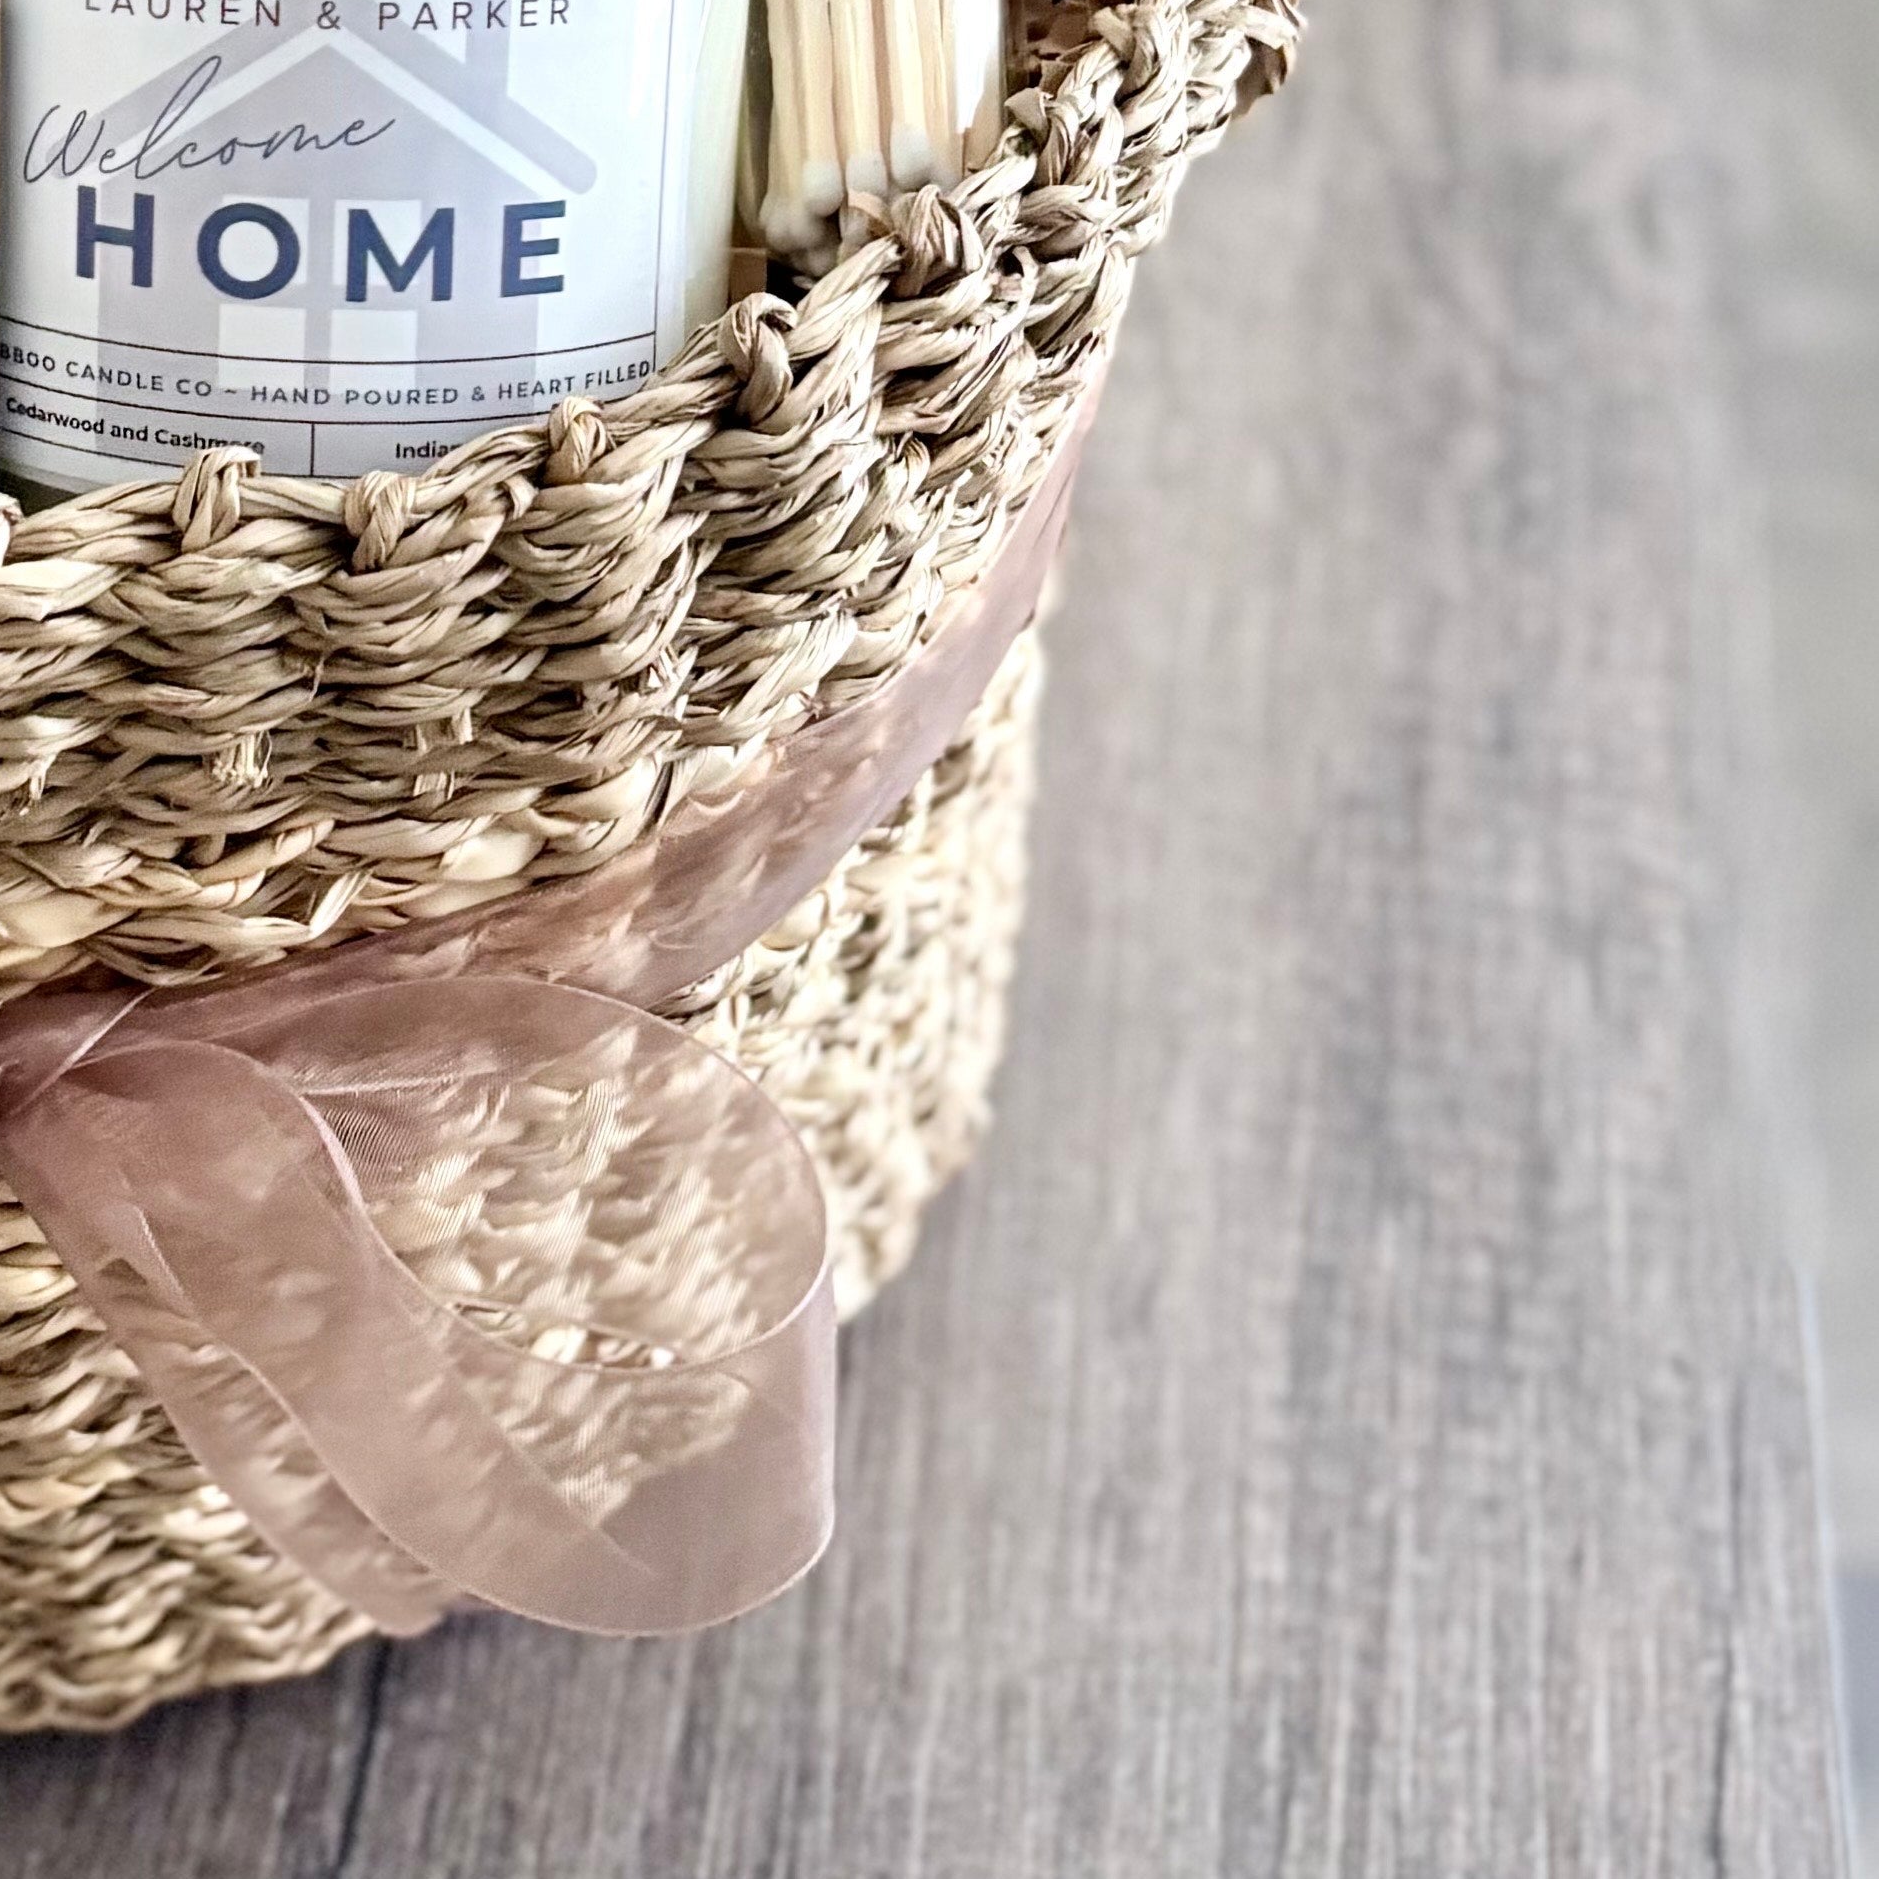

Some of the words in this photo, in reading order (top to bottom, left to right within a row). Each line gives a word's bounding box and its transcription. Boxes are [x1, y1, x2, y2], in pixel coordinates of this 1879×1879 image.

[316, 0, 342, 31] &
[23, 55, 397, 184] Welcome
[74, 185, 568, 303] HOME
[66, 361, 164, 392] CANDLE
[176, 379, 213, 398] CO
[250, 384, 331, 406] HAND
[346, 387, 459, 406] POURED
[472, 385, 486, 402] &
[498, 375, 576, 401] HEART
[585, 360, 650, 391] FILLED
[6, 396, 106, 436] Cedarwood
[110, 424, 149, 443] and
